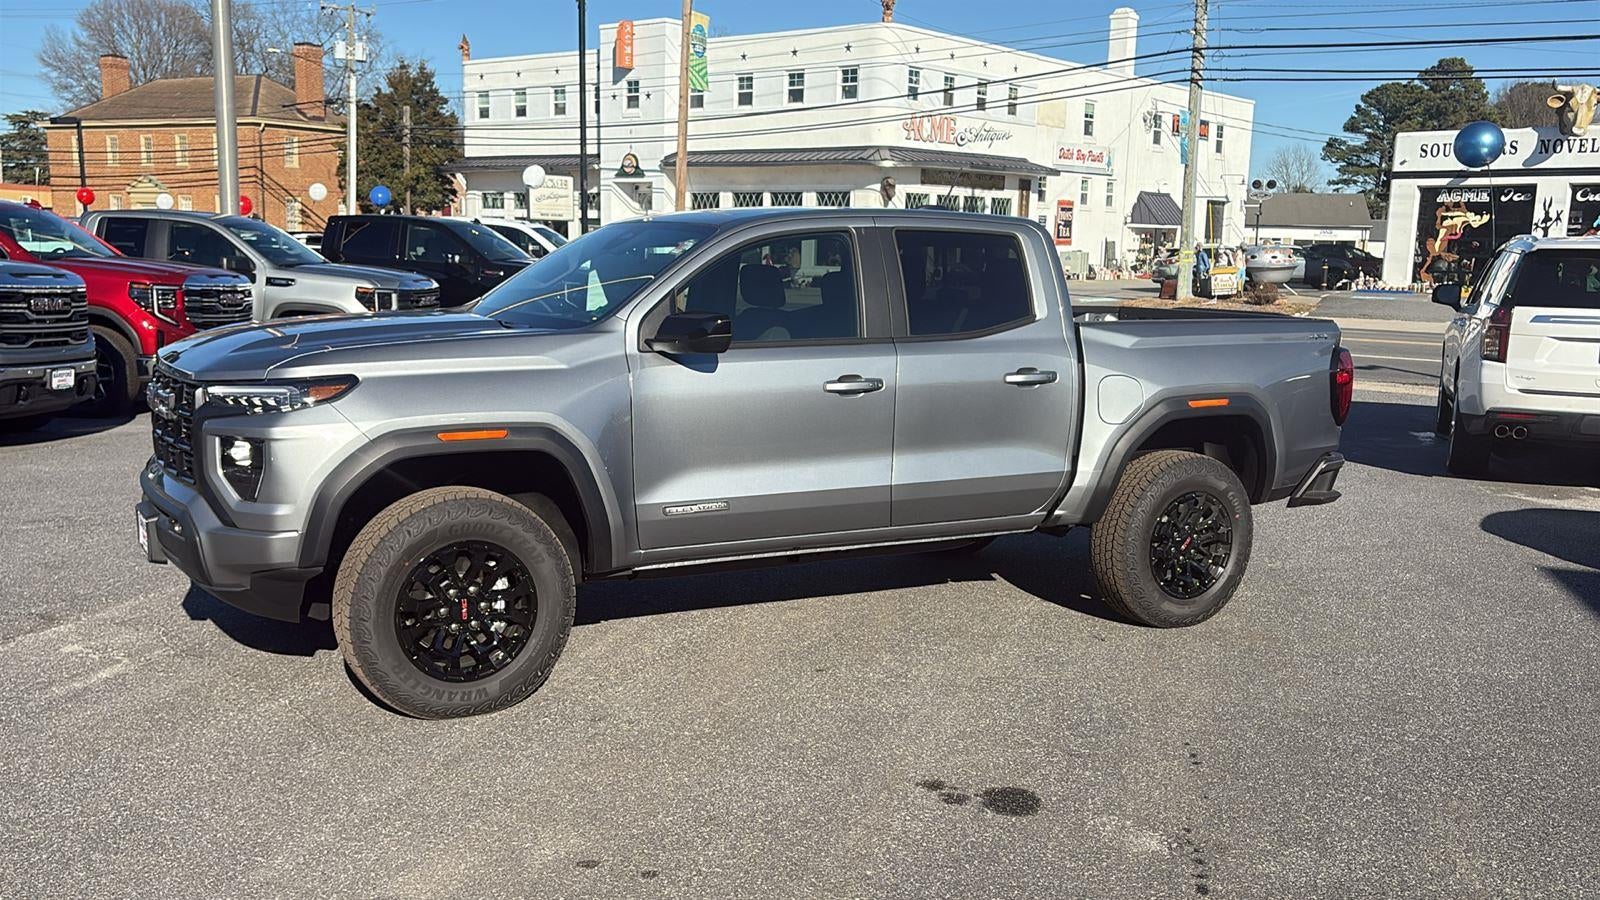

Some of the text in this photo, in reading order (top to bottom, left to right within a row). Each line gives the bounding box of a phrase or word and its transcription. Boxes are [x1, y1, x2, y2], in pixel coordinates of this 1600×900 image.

[902, 112, 957, 145] ACME
[967, 122, 1013, 149] Antiques
[1058, 147, 1104, 164] Dutch Boy Paints
[1436, 188, 1491, 203] ACME
[1501, 188, 1532, 202] Ice
[30, 297, 71, 311] GMC
[664, 502, 728, 515] ELEVATION
